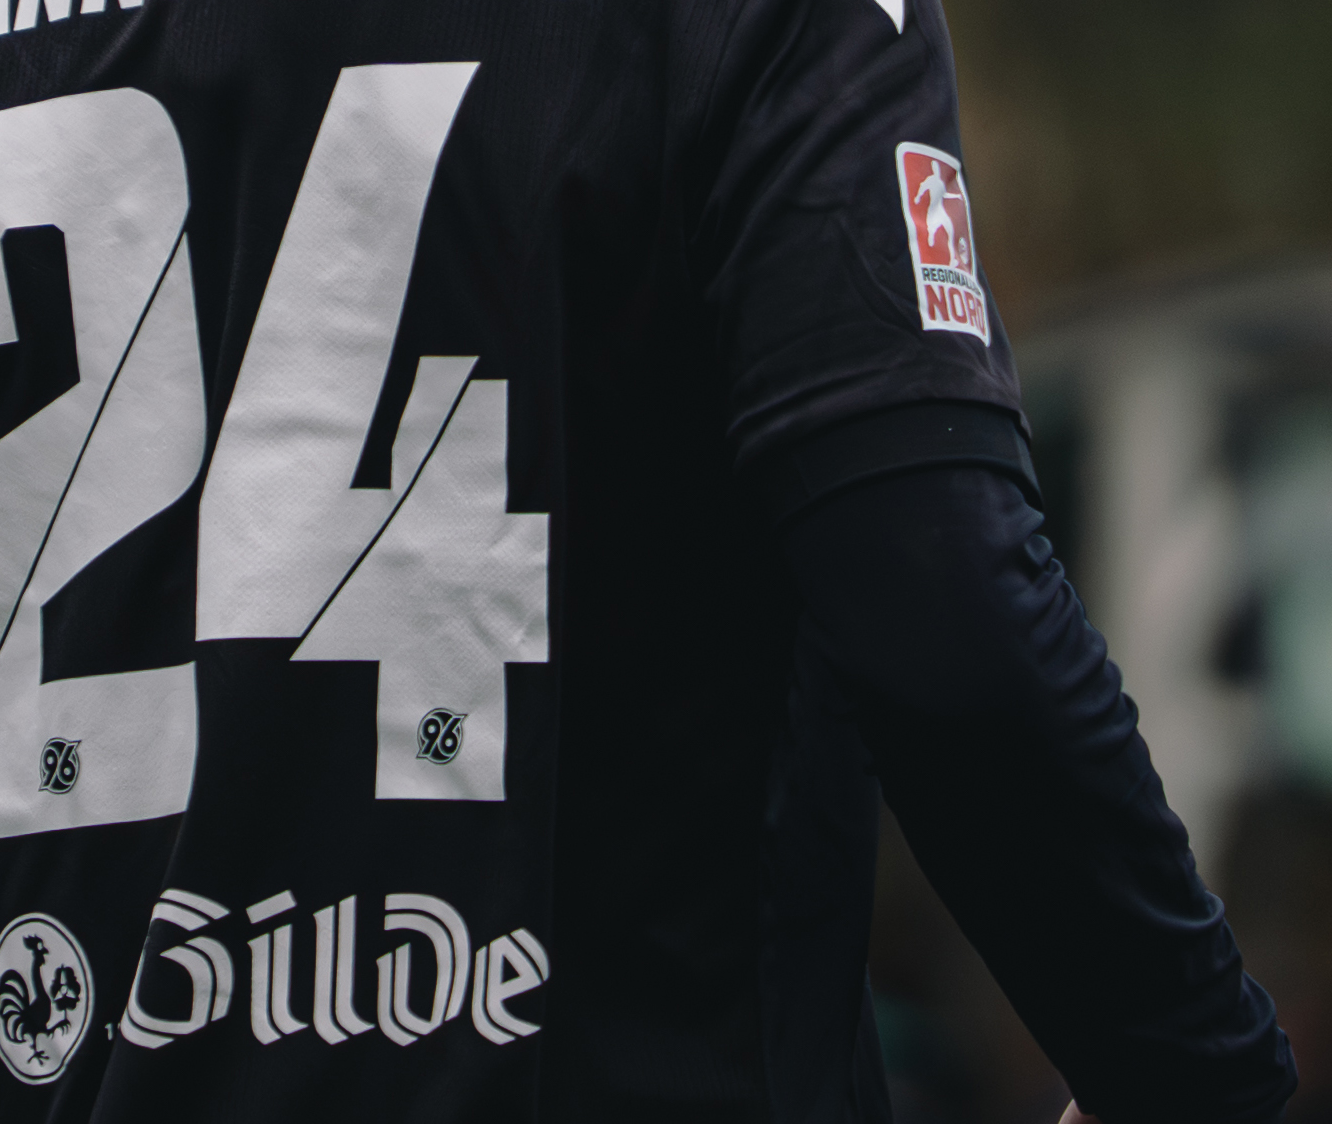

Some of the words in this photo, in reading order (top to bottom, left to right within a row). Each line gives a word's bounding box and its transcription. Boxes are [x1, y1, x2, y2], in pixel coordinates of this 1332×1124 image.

[924, 284, 986, 337] NORD
[419, 713, 464, 758] 96
[40, 742, 78, 790] 96
[120, 888, 550, 1049] Gilde
